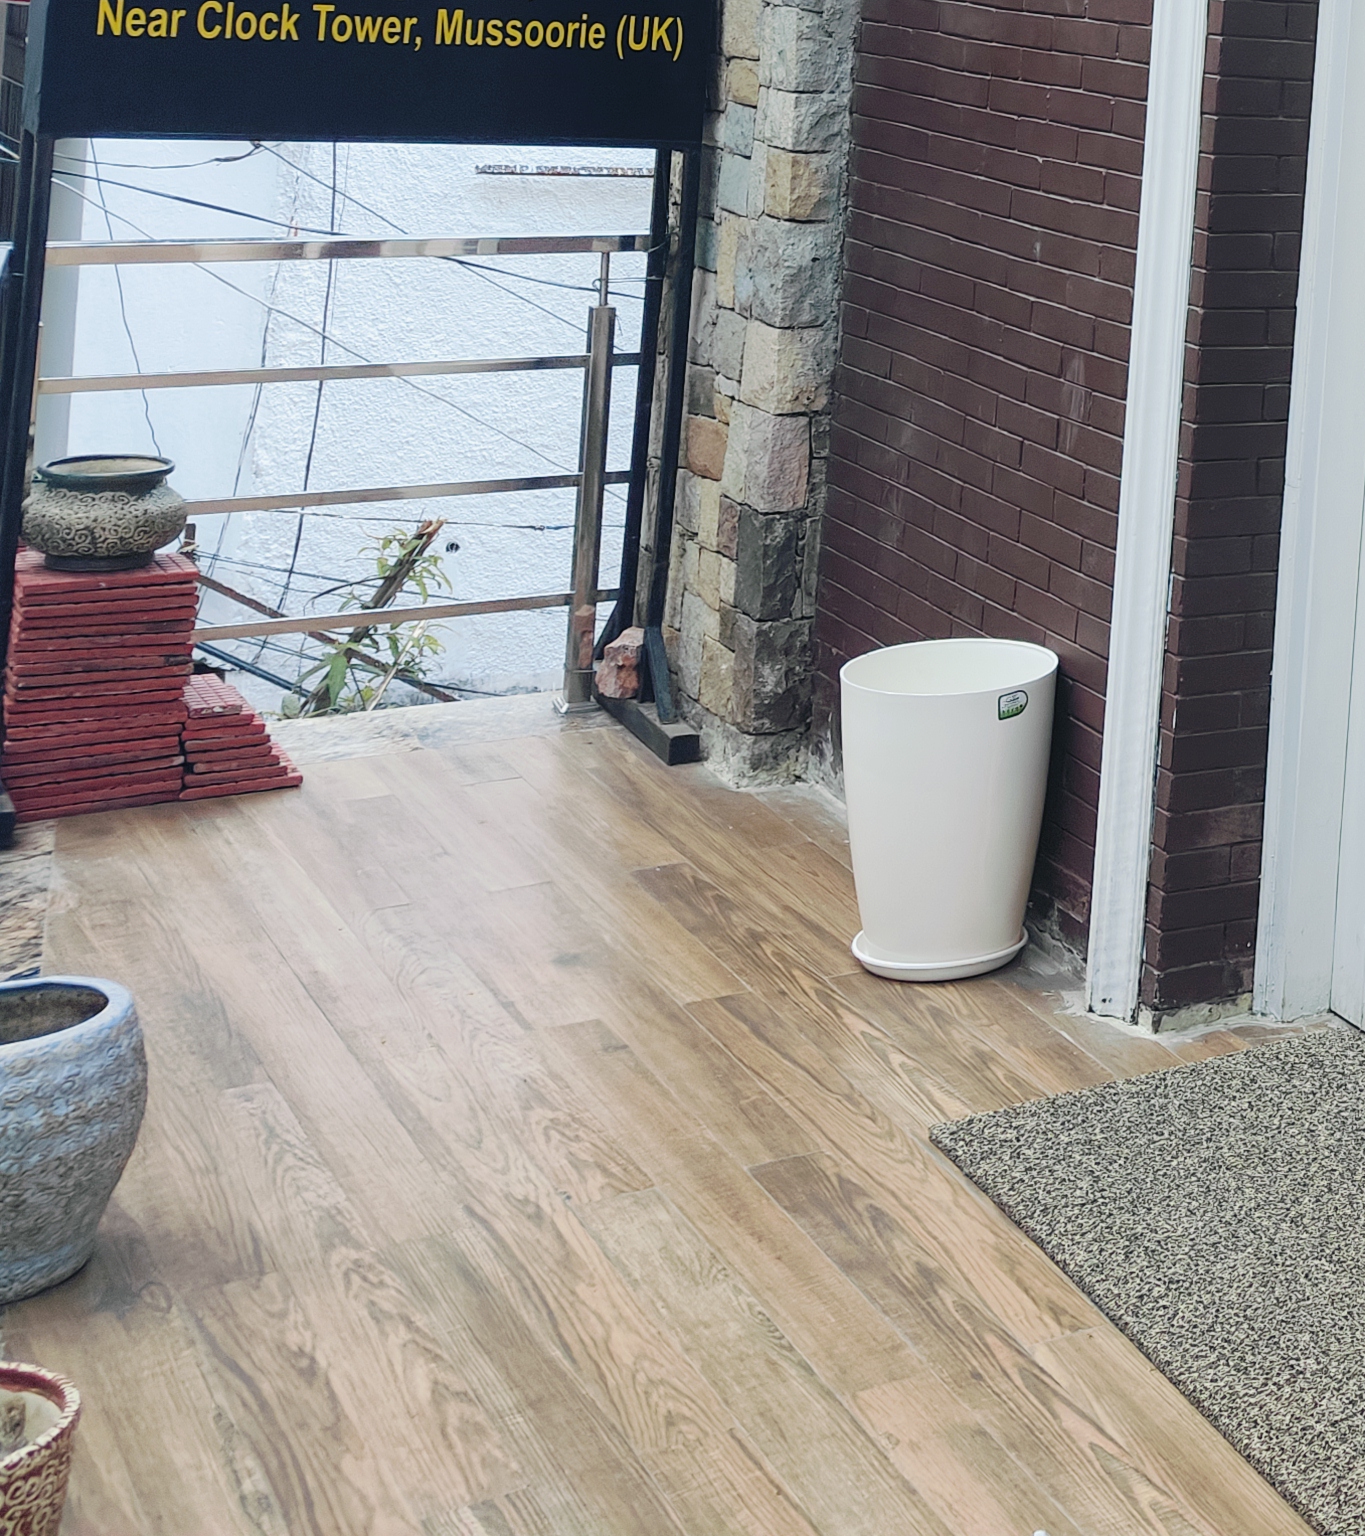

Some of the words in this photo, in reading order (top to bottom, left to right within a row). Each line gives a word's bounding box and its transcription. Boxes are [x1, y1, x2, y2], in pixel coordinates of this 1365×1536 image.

[196, 0, 301, 42] Clock
[312, 3, 422, 52] Tower,
[435, 8, 606, 50] Mussoorie
[616, 14, 684, 62] (UK)
